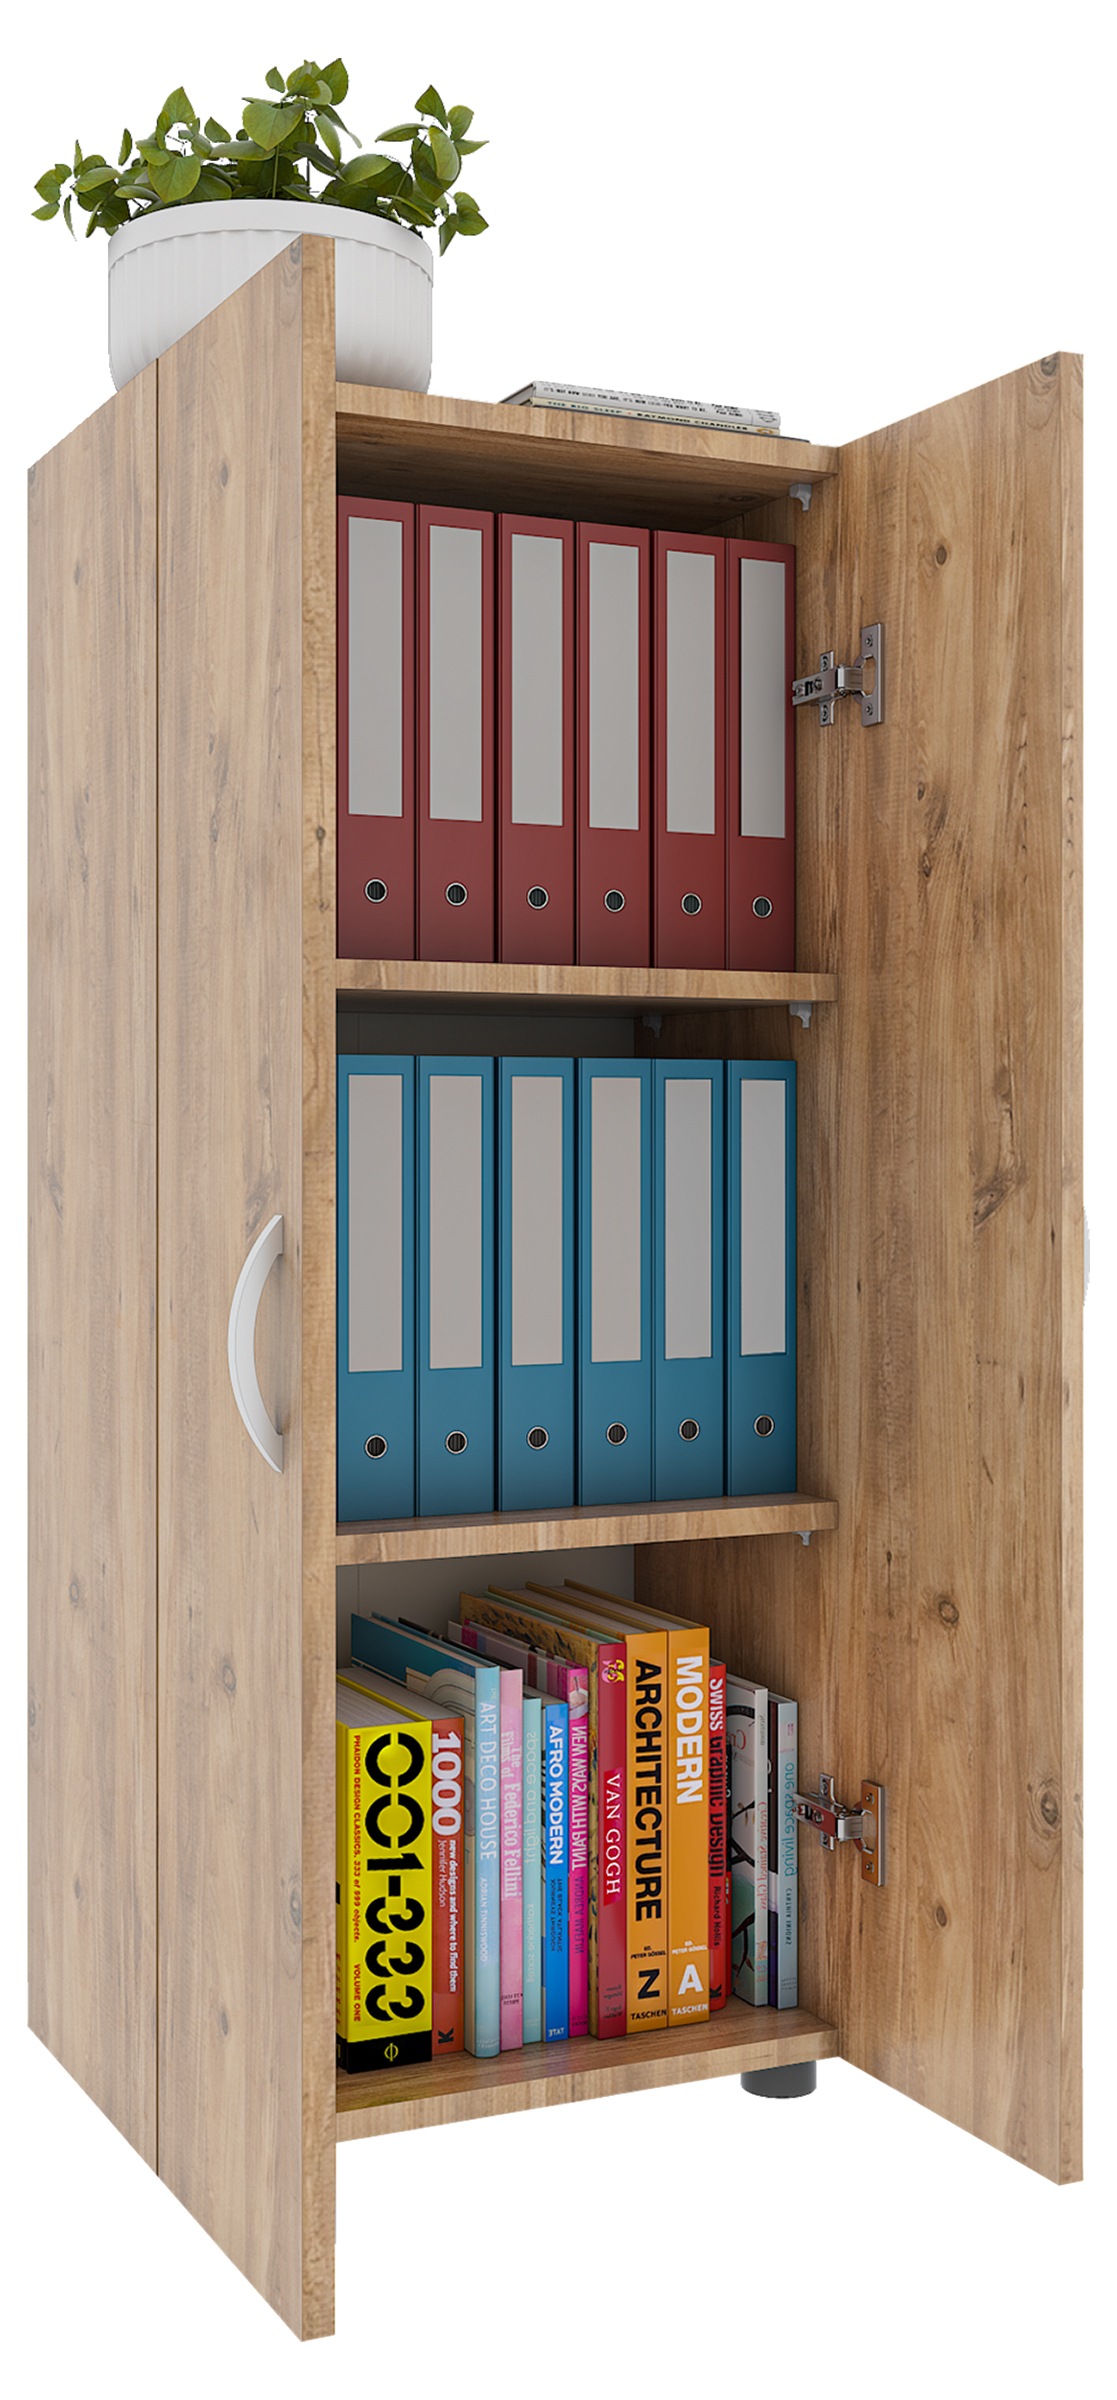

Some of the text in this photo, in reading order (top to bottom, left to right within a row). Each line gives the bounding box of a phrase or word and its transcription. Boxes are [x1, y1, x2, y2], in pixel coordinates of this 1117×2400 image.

[709, 1678, 723, 1731] SWISS
[676, 1655, 704, 1804] MODERN
[353, 1735, 361, 1775] PHAIDON
[511, 1745, 522, 1768] The
[353, 1777, 361, 1810] DESIGN
[432, 1731, 462, 1836] 1000
[480, 1702, 497, 1861] ART DECO HOUSE
[549, 1725, 564, 1865] AFRO MODERN
[635, 1659, 662, 1922] ARCHITECTURE
[449, 1840, 457, 1859] new
[504, 1782, 522, 1898] Federico Fellini
[605, 1773, 621, 1894] VAN GOGH
[353, 1861, 361, 1877] 333
[353, 1879, 361, 1887] of
[448, 1861, 459, 1894] designs
[353, 1889, 361, 1906] 999
[438, 1873, 447, 1908] Hudson
[449, 1895, 458, 1913] and
[713, 1886, 721, 1919] Richard
[449, 1914, 458, 1941] where
[353, 1964, 361, 2022] VOLUME ONE
[638, 1968, 660, 2000] Z
[678, 1963, 704, 1996] A
[630, 2010, 667, 2021] TASCHEN
[671, 2003, 709, 2016] TASCHEN
